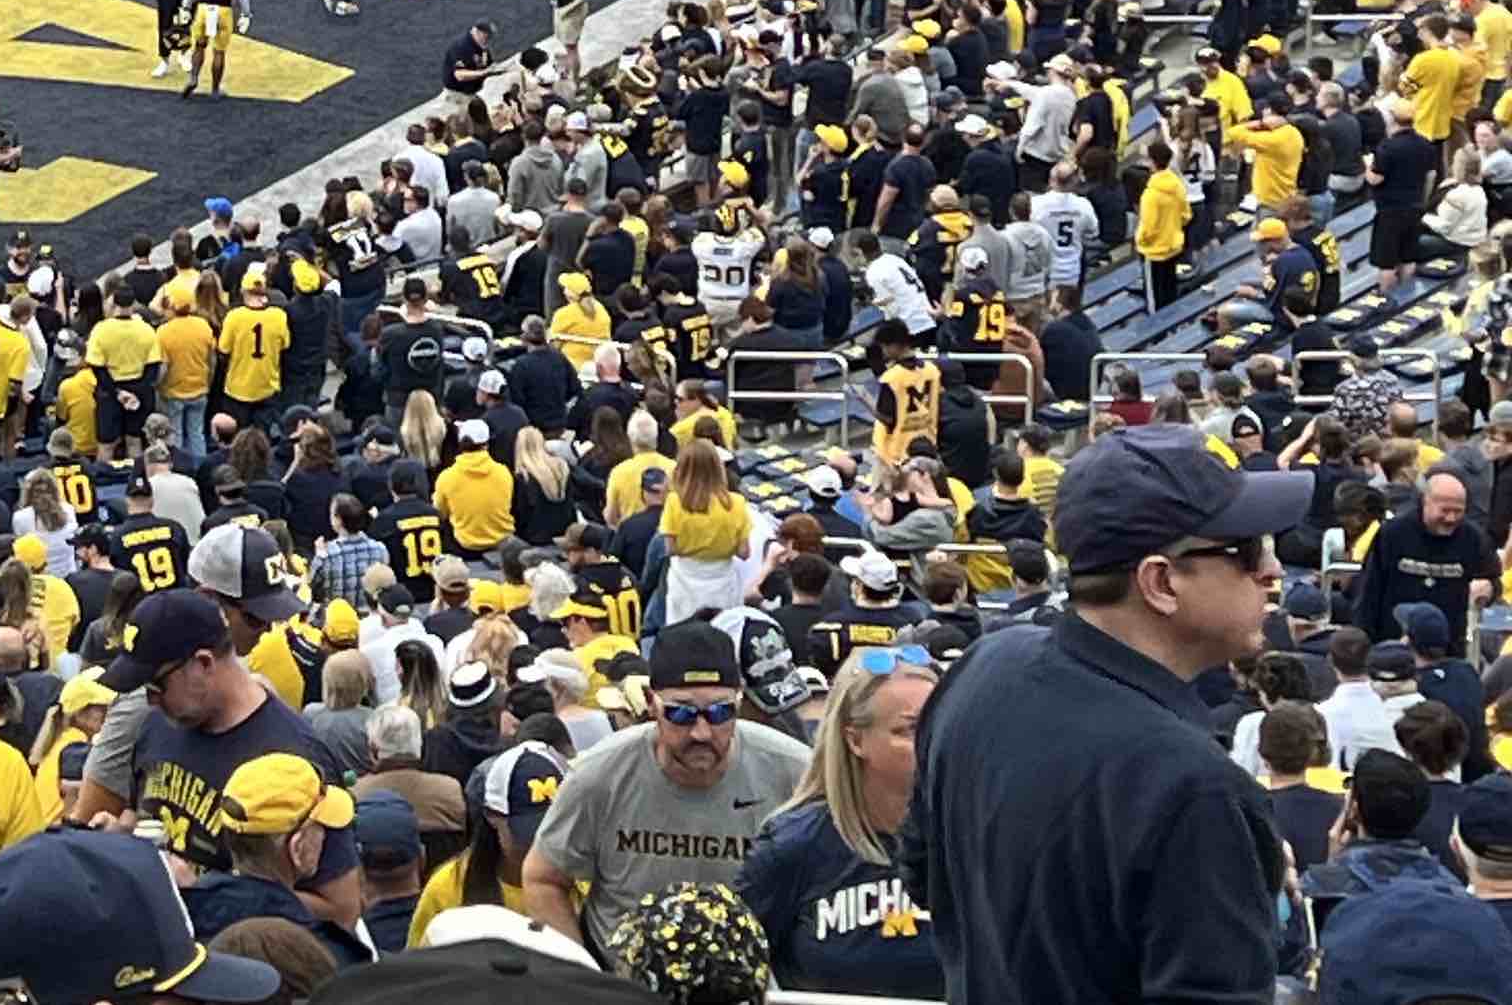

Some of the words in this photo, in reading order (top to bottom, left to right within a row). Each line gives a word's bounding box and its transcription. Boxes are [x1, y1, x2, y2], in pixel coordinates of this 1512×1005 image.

[1057, 222, 1074, 247] 5
[251, 323, 266, 359] 1
[973, 304, 1005, 342] 19
[905, 380, 931, 412] M
[57, 474, 93, 514] 10
[131, 546, 177, 592] 19
[402, 529, 442, 578] 19
[602, 589, 642, 644] 10
[527, 776, 558, 803] M
[880, 909, 919, 939] M
